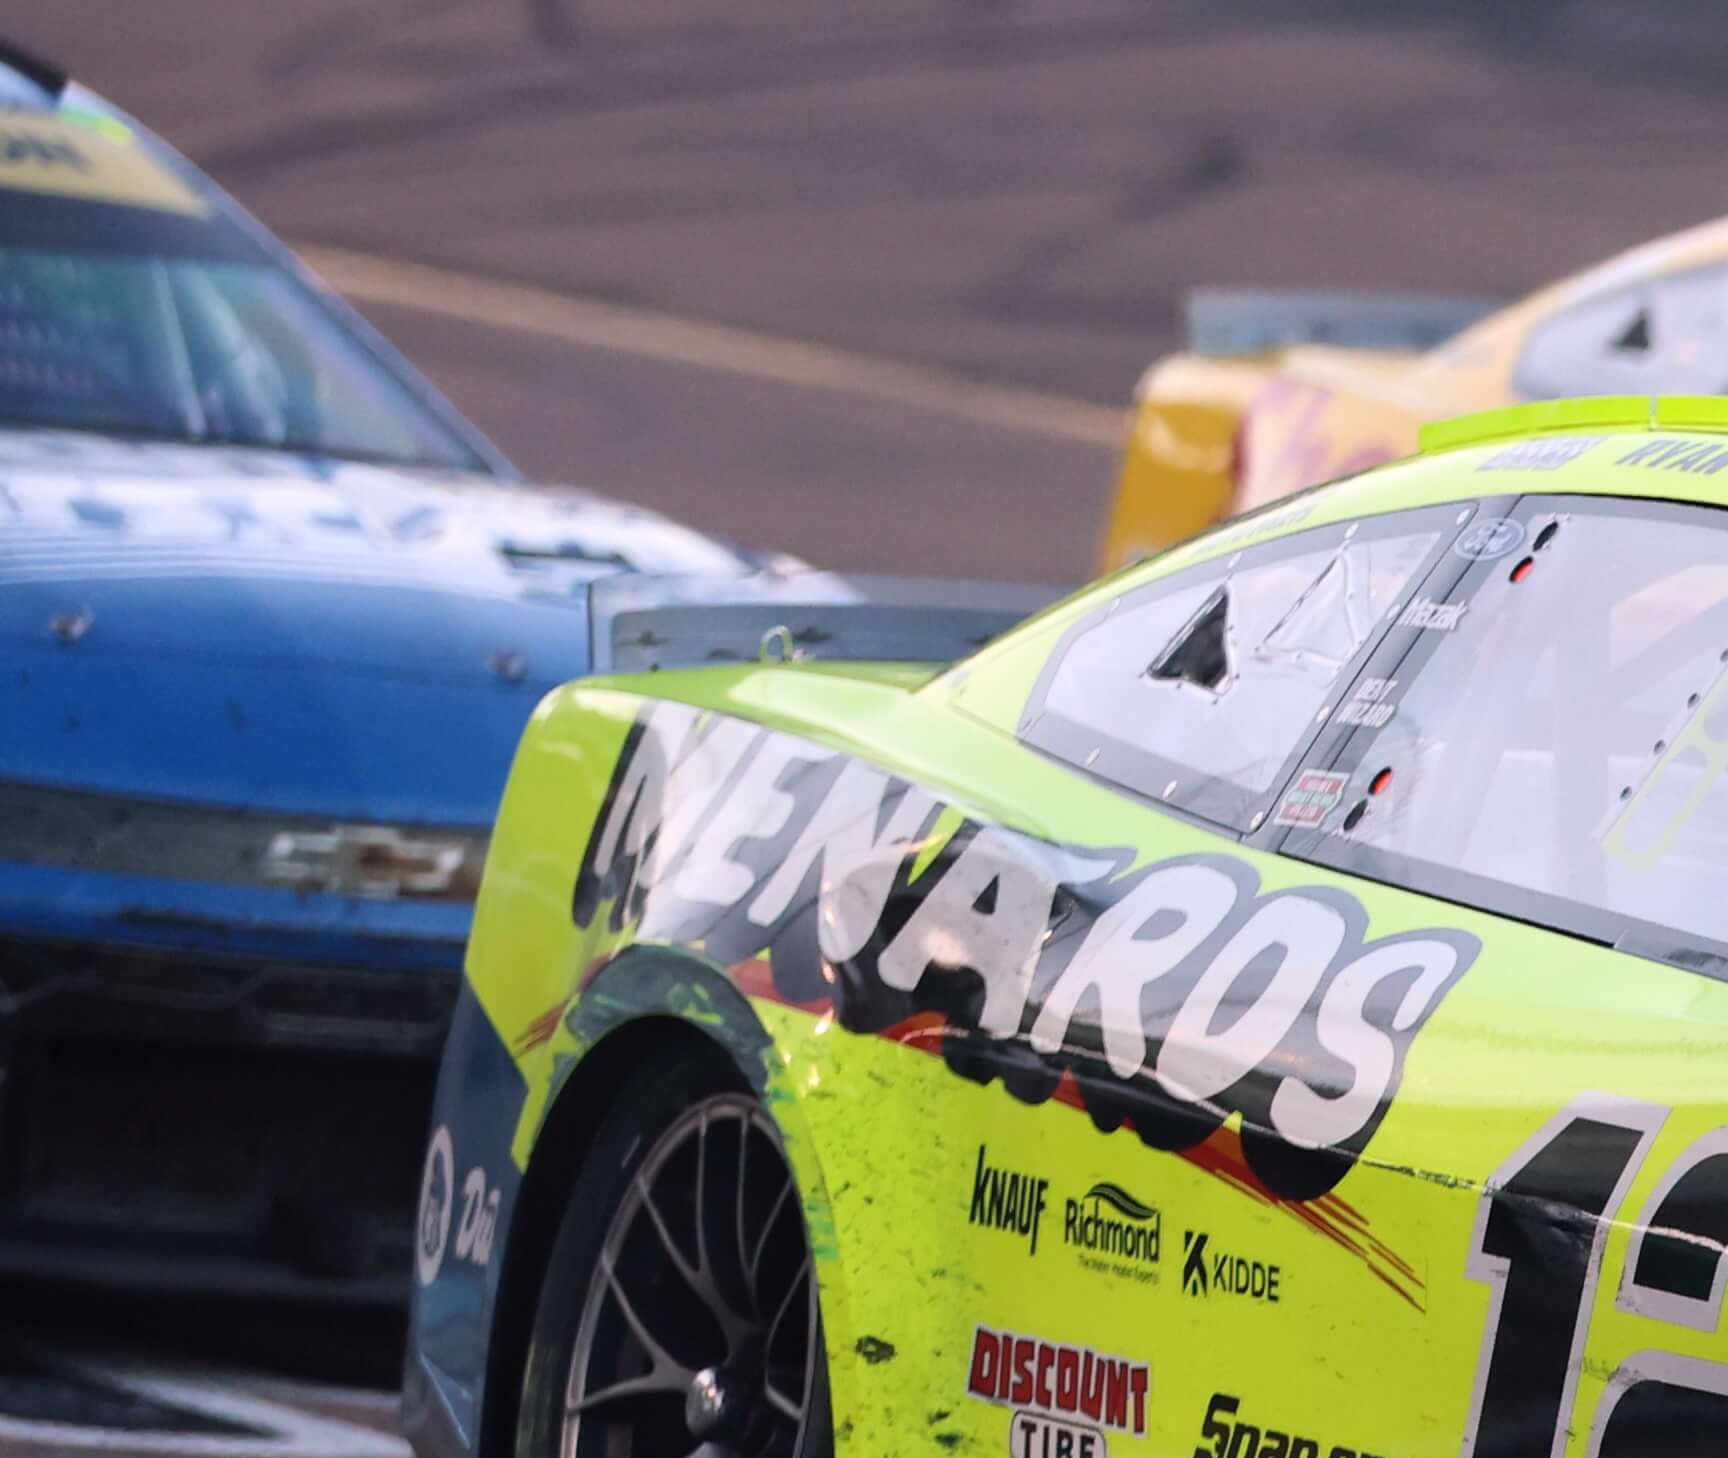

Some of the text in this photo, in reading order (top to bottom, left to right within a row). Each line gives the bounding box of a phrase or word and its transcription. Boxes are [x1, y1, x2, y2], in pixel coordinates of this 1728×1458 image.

[595, 700, 1457, 1150] MENARDS
[968, 1145, 1049, 1257] KNAUF
[1063, 1197, 1161, 1263] Richmond
[1213, 1253, 1280, 1303] KIDDE
[967, 1326, 1149, 1434] DISCOUNT
